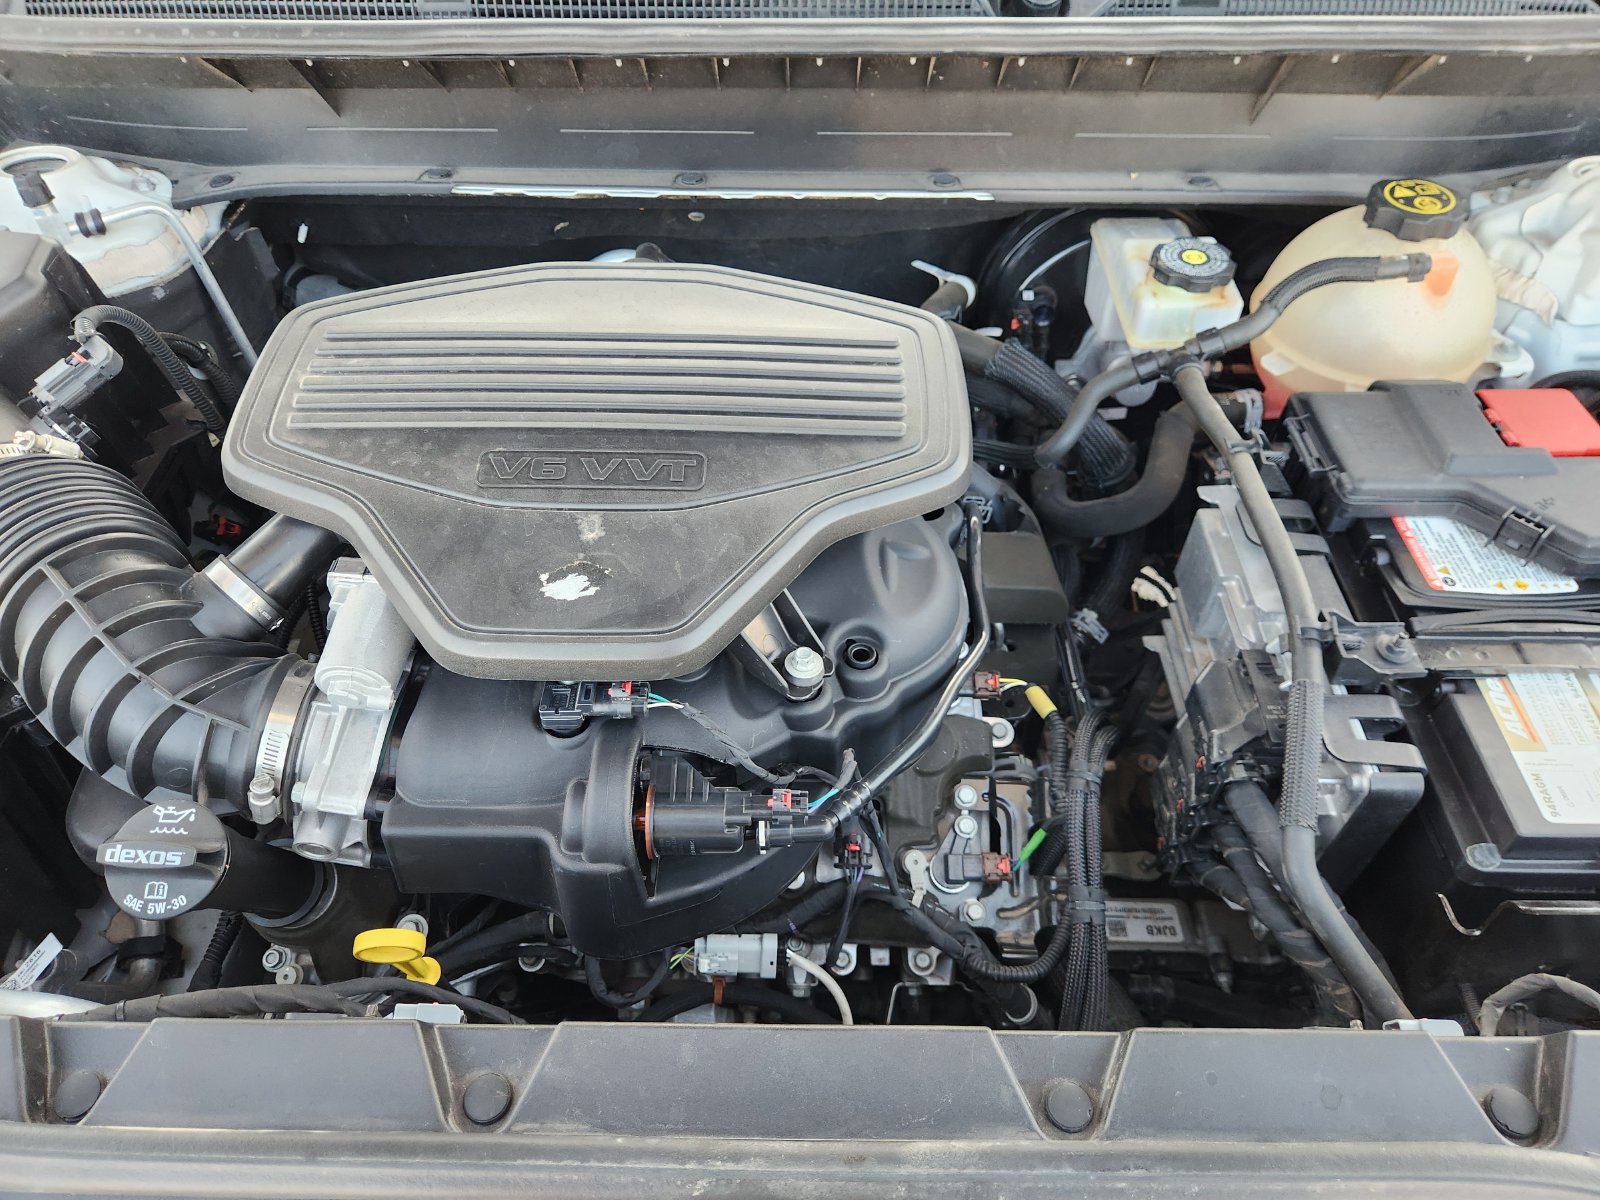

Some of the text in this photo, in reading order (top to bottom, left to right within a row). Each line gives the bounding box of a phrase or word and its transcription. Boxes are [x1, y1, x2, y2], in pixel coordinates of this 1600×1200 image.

[489, 455, 697, 482] V6 VVT
[1530, 772, 1561, 818] 94RAGM
[104, 844, 185, 866] dexos
[123, 894, 188, 914] SAE 5W-30
